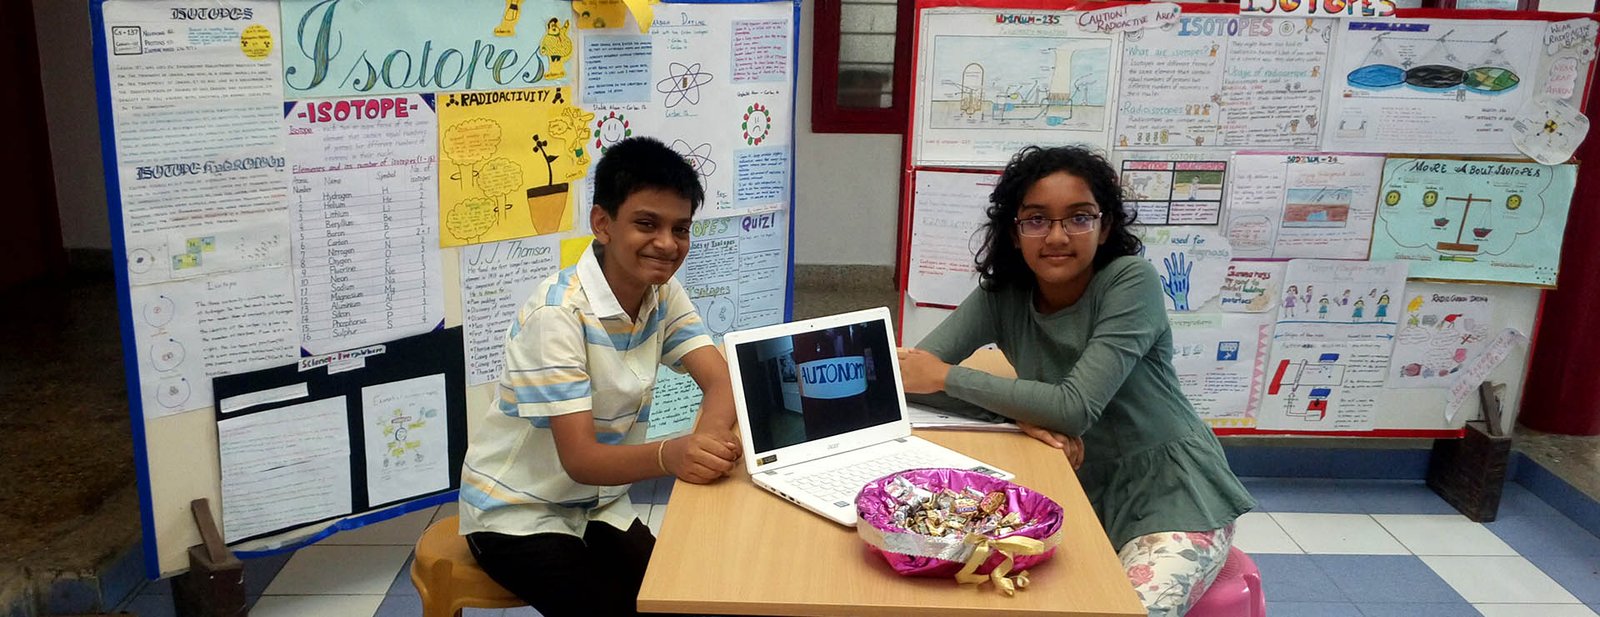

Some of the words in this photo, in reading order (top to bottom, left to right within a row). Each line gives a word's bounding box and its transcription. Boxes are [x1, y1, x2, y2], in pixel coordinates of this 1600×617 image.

[1177, 17, 1274, 37] ISOTOPES
[285, 0, 545, 91] Isotopes
[461, 91, 550, 107] RADIOACTIVITY
[322, 192, 352, 204] Hydrogen
[323, 201, 346, 210] Helium
[326, 230, 346, 238] Boron
[691, 217, 731, 238] OPES
[1171, 234, 1189, 245] used
[1191, 234, 1206, 245] for
[506, 240, 551, 260] Thomson
[330, 275, 348, 283] Neon
